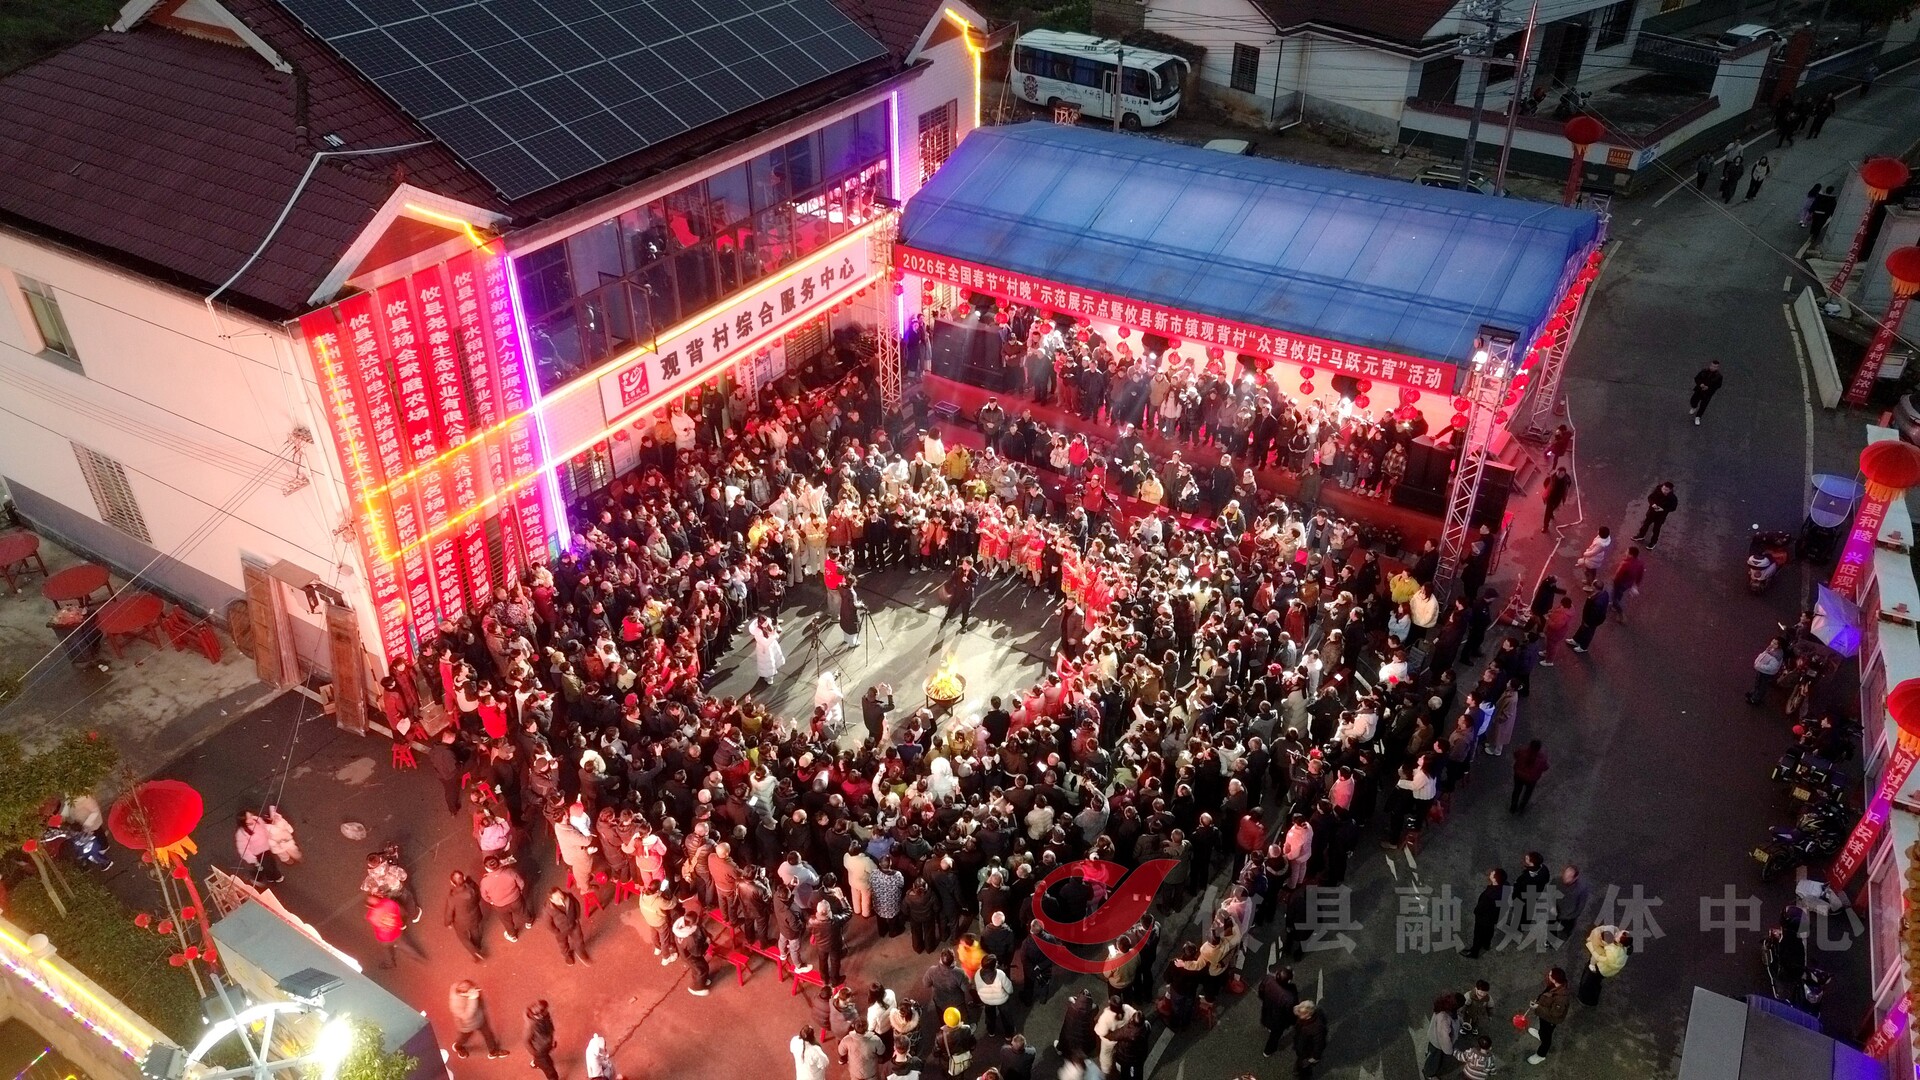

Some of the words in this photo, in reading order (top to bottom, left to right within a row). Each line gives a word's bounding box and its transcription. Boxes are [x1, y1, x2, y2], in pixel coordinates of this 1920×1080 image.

[386, 300, 430, 422] 攸县扬全家庭农场
[420, 286, 467, 448] 攸县尧泰生态农业有限公司
[453, 271, 498, 431] 攸县鑫丰水稻种植专业合作
[485, 255, 524, 412] 株洲市新希望人力资源公司
[660, 257, 855, 381] 观背村综合服务中心
[903, 252, 1442, 390] 2026年全国春节“村晚”示范展示点暨攸县新市镇观背村“众望攸归·马跃元宵”活动
[1856, 343, 1885, 388] 乡村年味浓
[1853, 494, 1883, 543] 里和睦
[410, 582, 438, 645] 全国村晚展风
